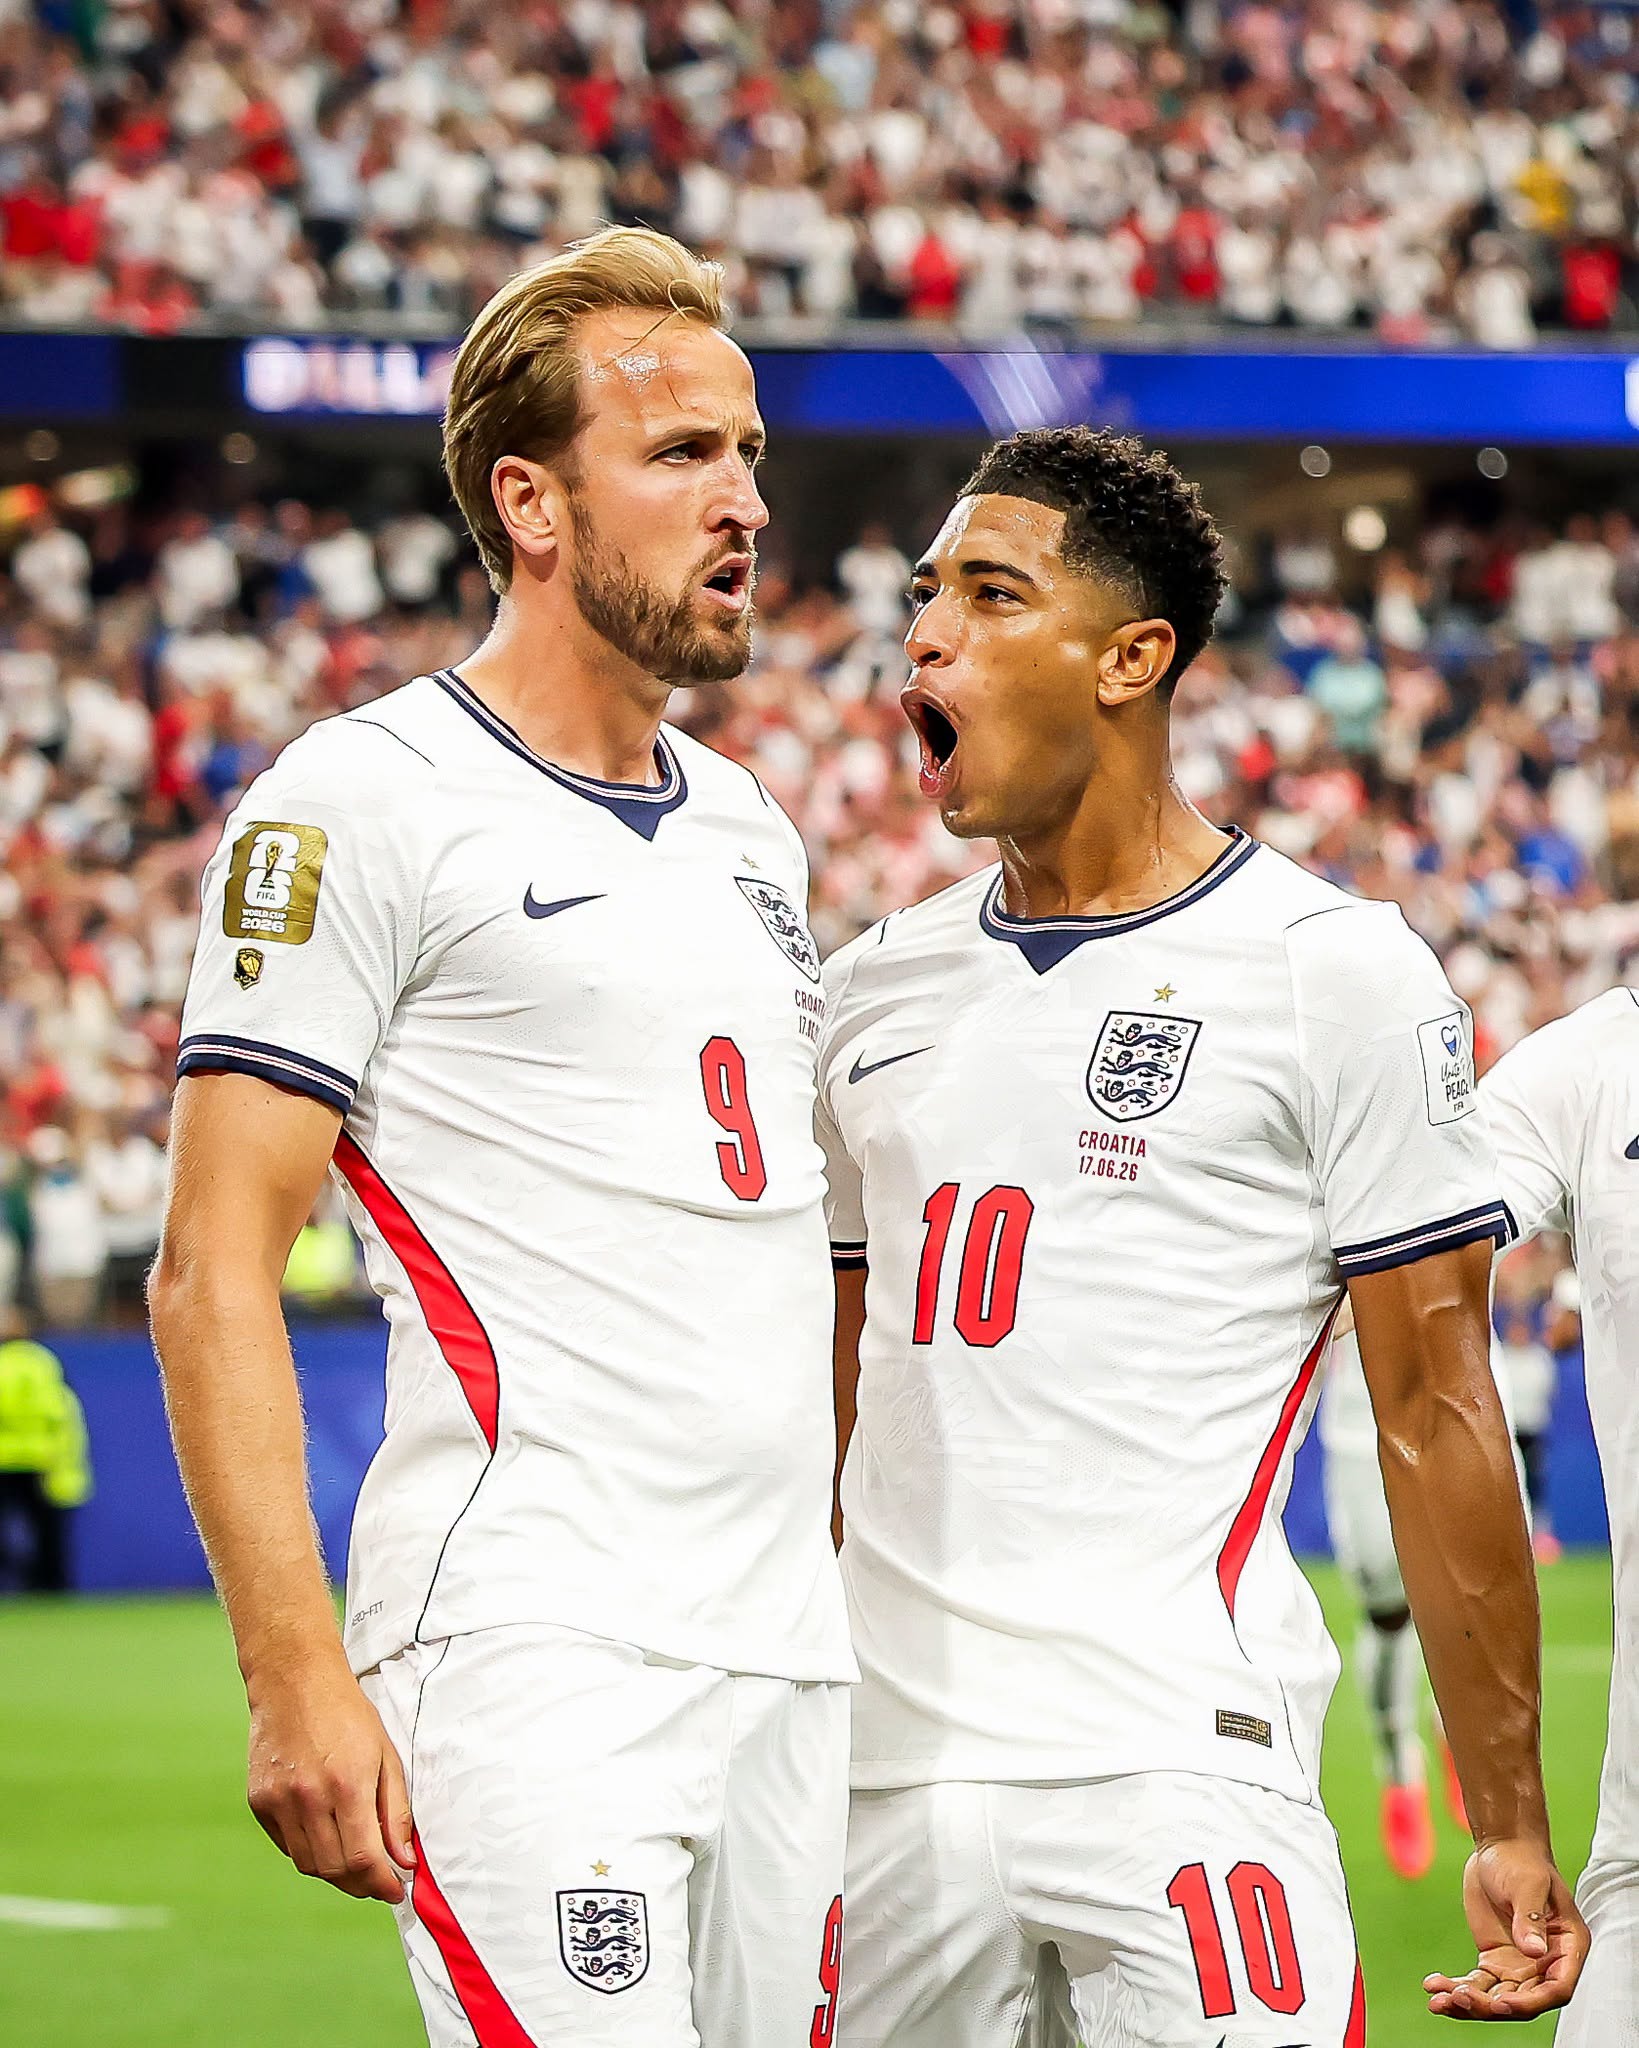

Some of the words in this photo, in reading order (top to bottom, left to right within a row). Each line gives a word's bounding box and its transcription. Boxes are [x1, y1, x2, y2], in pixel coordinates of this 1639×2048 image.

[256, 891, 276, 901] FIFA
[240, 917, 286, 934] 2026
[269, 911, 288, 921] CUP
[700, 1036, 767, 1201] 9
[1078, 1130, 1146, 1158] CROATIA
[1078, 1155, 1138, 1181] 17.06.26
[912, 1182, 1034, 1348] 10
[1166, 1861, 1305, 2019] 10
